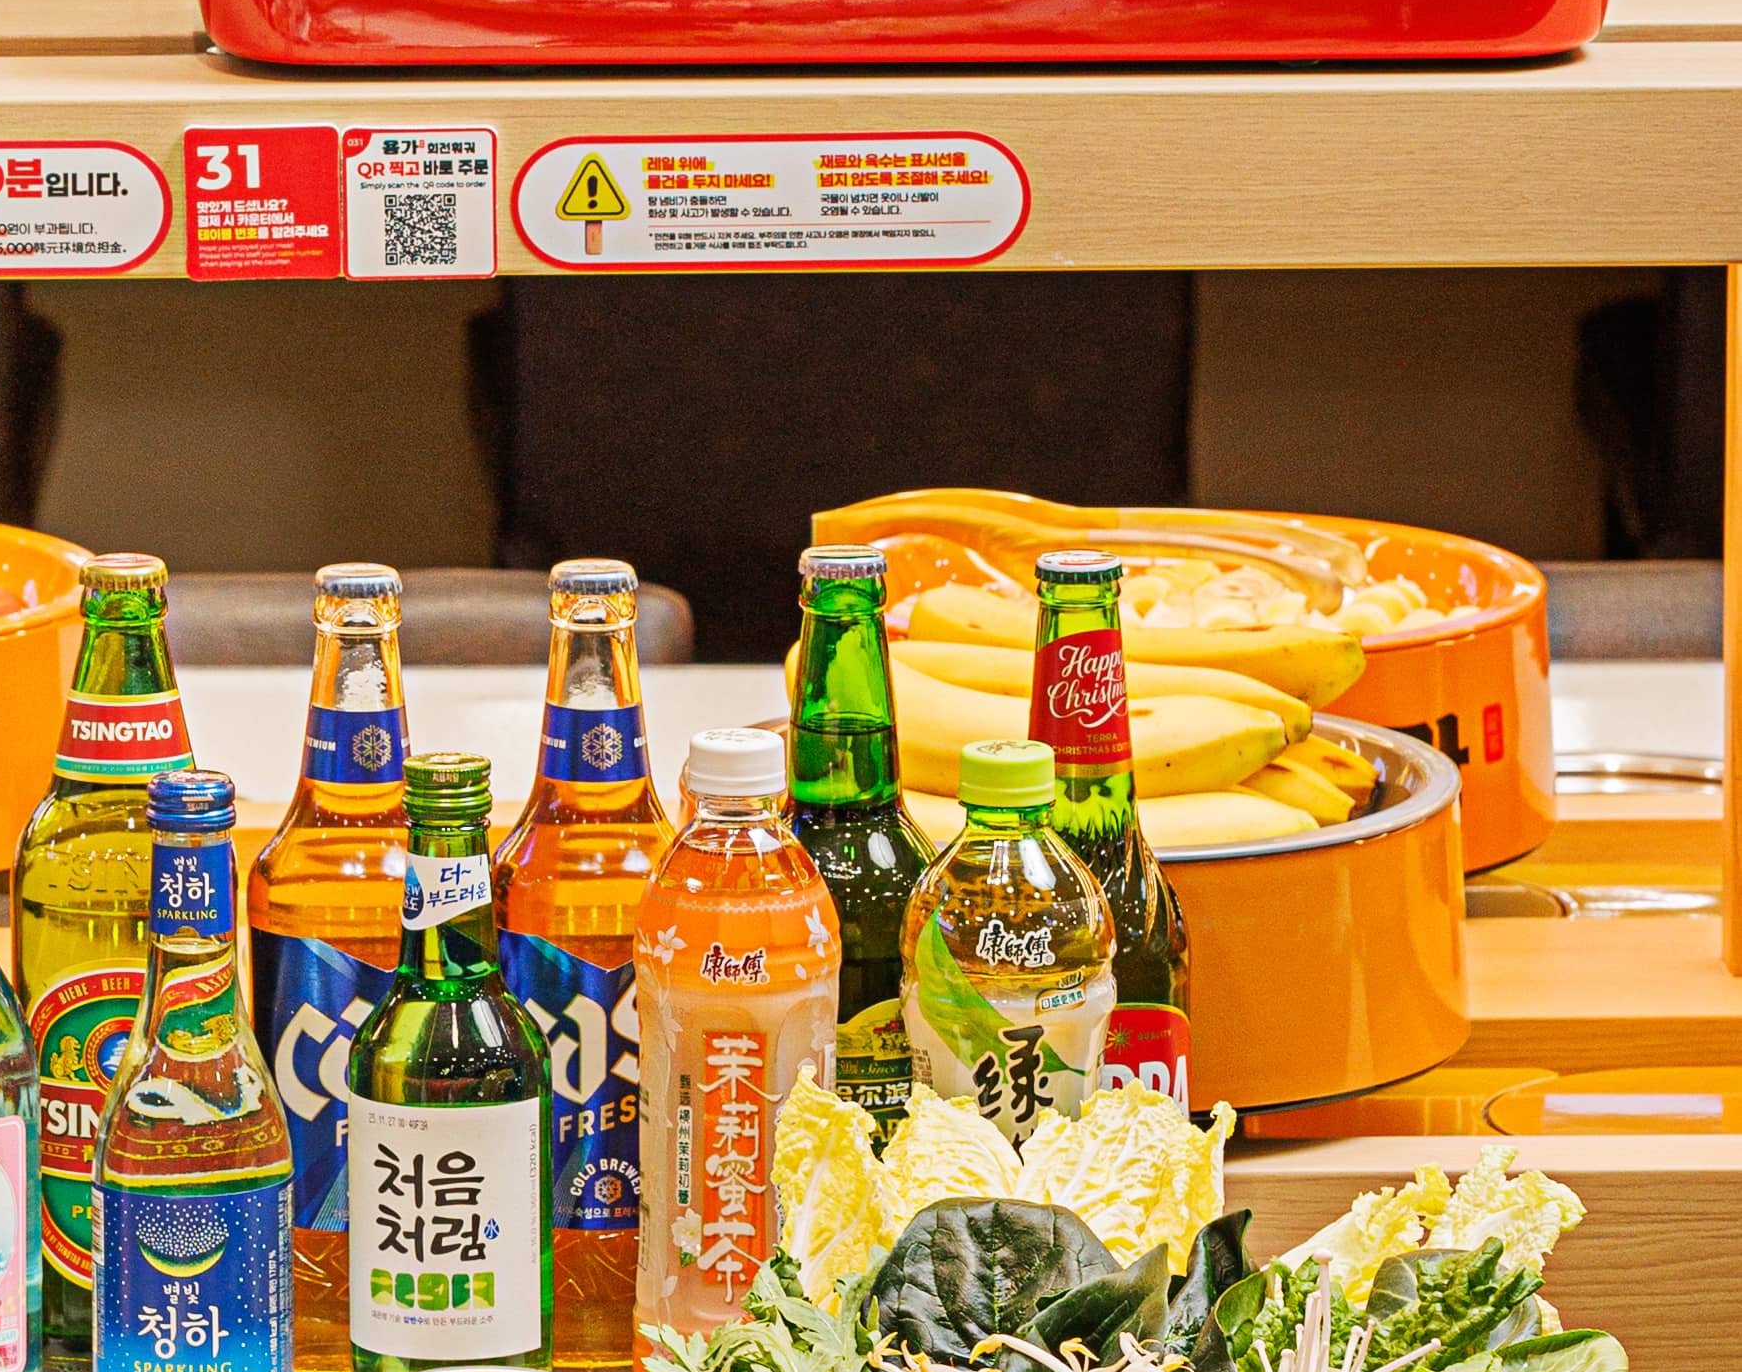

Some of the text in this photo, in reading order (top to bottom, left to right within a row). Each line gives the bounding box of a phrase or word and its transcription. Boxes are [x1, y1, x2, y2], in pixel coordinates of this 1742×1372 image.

[347, 138, 363, 147] 031
[382, 138, 419, 155] 용가
[196, 144, 260, 191] 31
[357, 159, 488, 179] QR 찍고 바로 주문
[647, 156, 707, 171] 레일 위에
[819, 152, 966, 169] 재료와 육수는 표시선을
[648, 173, 771, 189] 물건을 두지 마세요!
[820, 170, 989, 187] 넘지 않도록 조절해 주세요!
[196, 199, 288, 213] 맛있게 드셨나요?
[223, 214, 234, 226] 시
[237, 212, 294, 226] 카운터에서
[198, 227, 232, 241] 테이블
[272, 224, 329, 239] 알려주세요
[70, 719, 173, 742] TSINGTAO
[173, 855, 198, 873] 별빛
[159, 872, 216, 908] 청하
[426, 881, 487, 908] 부드러운
[157, 908, 218, 920] SPARKLING
[58, 977, 131, 1006] BIERE BEER
[559, 1094, 637, 1144] FRES
[374, 1143, 486, 1209] 처음
[569, 1162, 597, 1197] COLD
[697, 1035, 784, 1305] 茉莉蜜茶
[376, 1204, 487, 1264] 처럼
[162, 1281, 200, 1305] 별빛
[137, 1305, 230, 1359] 청하
